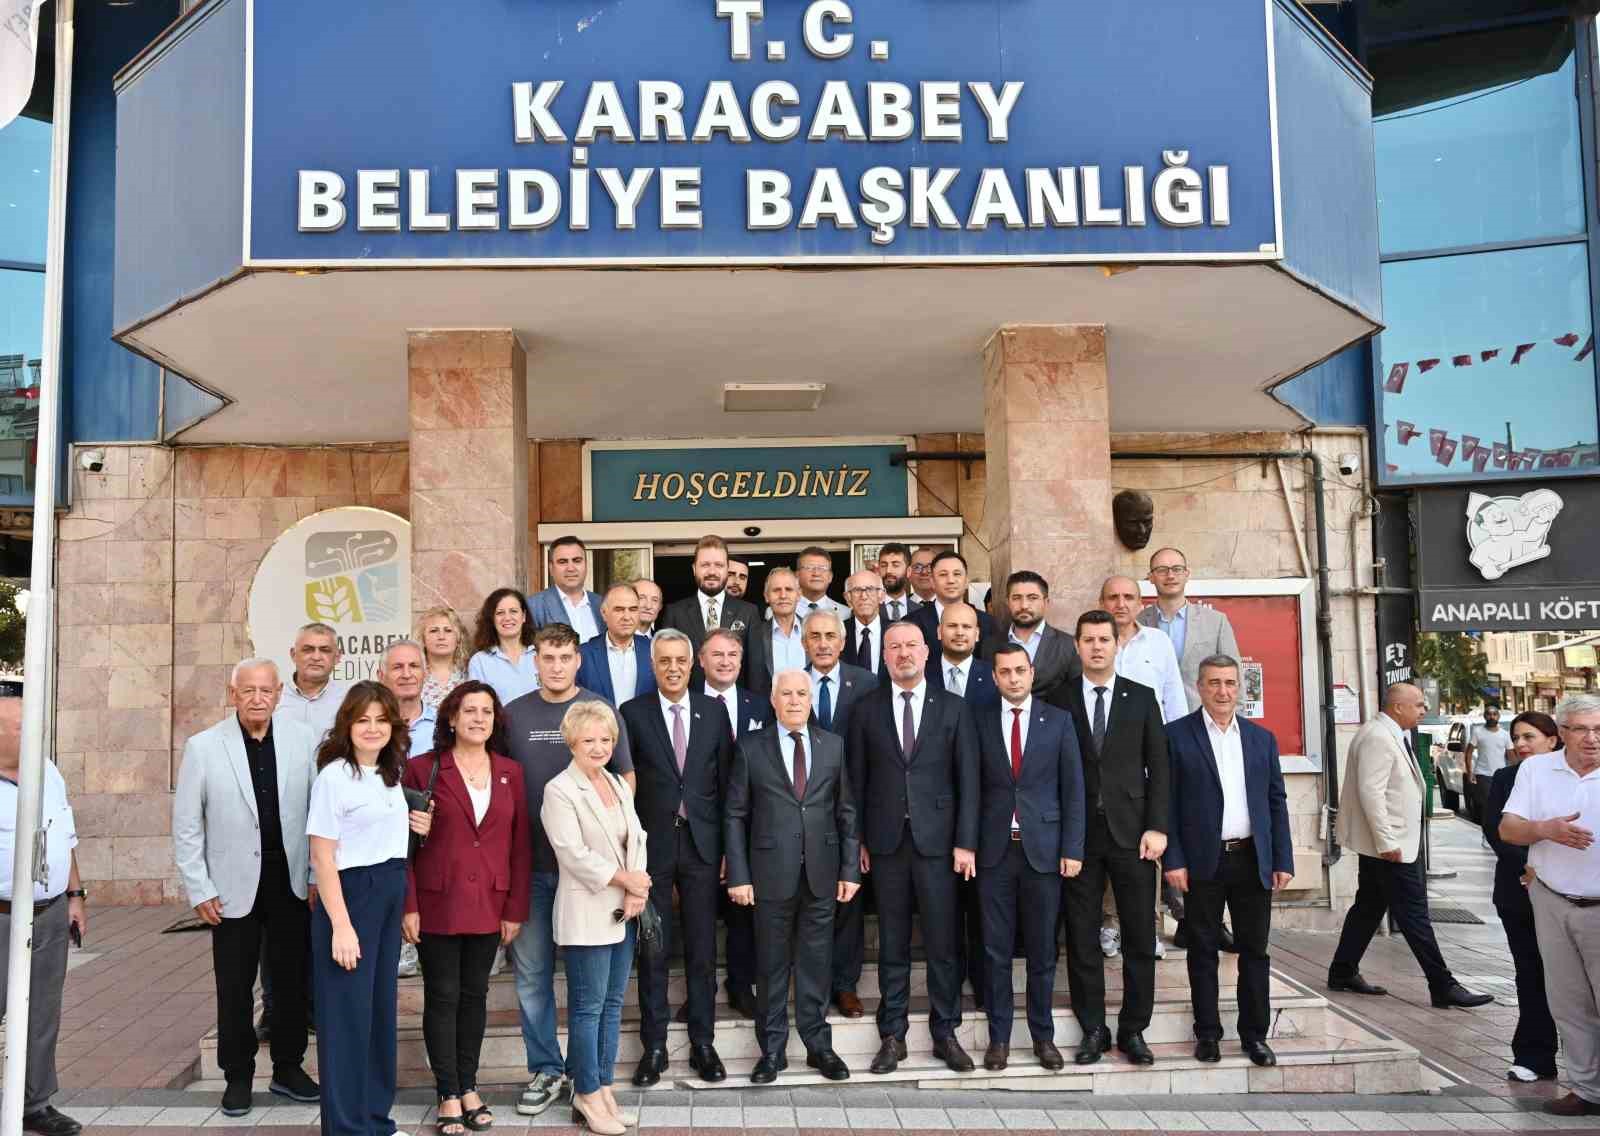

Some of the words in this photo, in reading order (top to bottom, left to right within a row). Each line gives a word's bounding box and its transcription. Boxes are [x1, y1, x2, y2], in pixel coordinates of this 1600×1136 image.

[716, 0, 889, 60] T.C.
[512, 80, 1024, 143] KARACABEY
[297, 147, 703, 231] BELEDİYE
[746, 150, 1231, 244] BAŞKANLIĞI
[632, 463, 871, 505] HOŞGELDİNİZ
[1432, 601, 1531, 622] ANAPALI
[1385, 643, 1407, 663] ET
[1385, 666, 1412, 685] TAVUK
